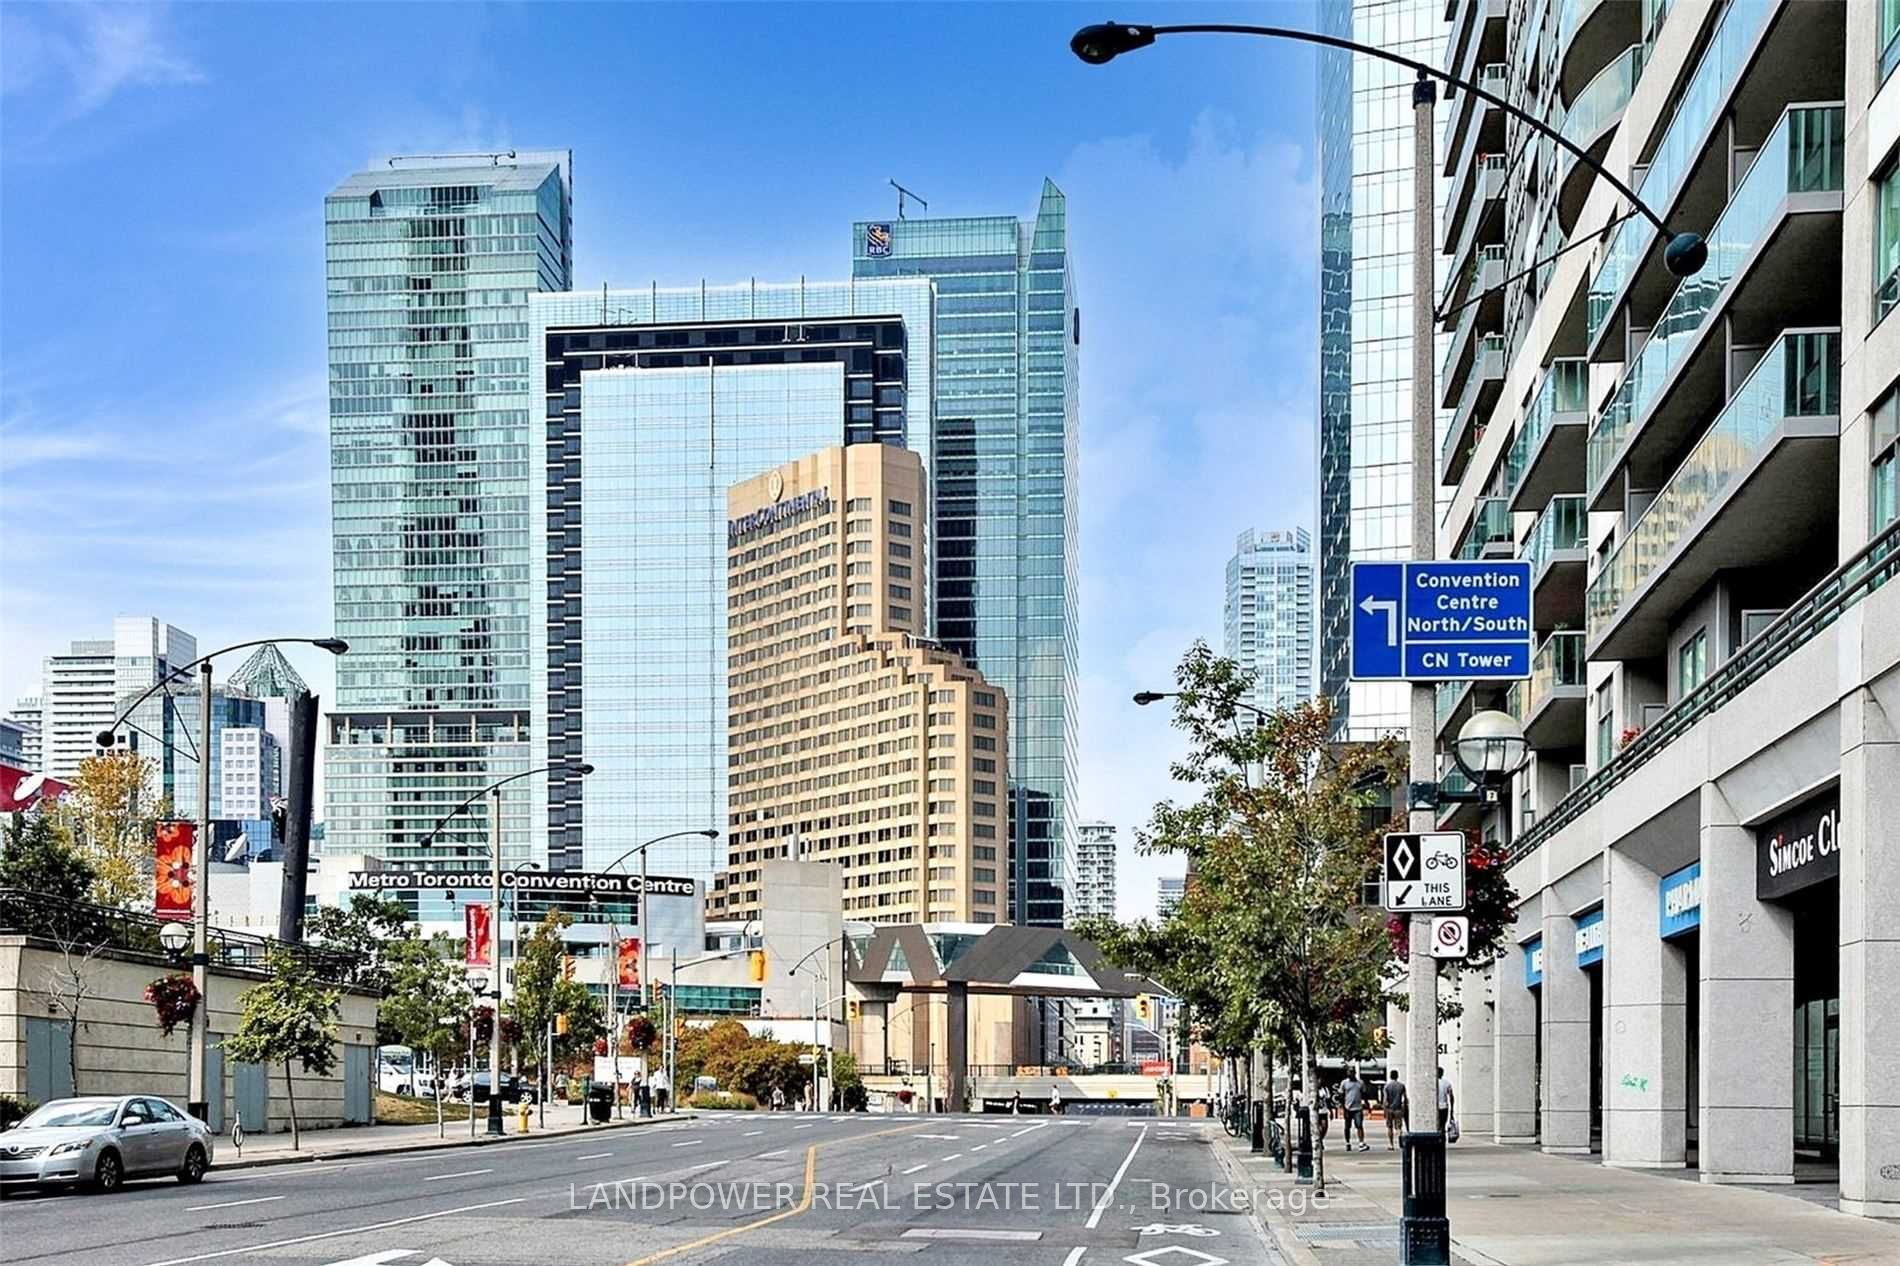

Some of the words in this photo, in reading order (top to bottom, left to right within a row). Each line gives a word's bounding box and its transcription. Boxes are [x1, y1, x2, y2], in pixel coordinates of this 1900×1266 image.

[1416, 573, 1520, 588] Convention
[1436, 595, 1498, 610] Centre
[1408, 617, 1527, 632] North/South
[1422, 653, 1448, 668] CN
[1458, 652, 1512, 668] Tower
[350, 872, 409, 887] Metro
[413, 872, 493, 887] Toronto
[501, 872, 621, 890] Convention
[627, 876, 694, 894] Centre
[1424, 883, 1450, 893] THIS
[1421, 896, 1452, 906] LANE
